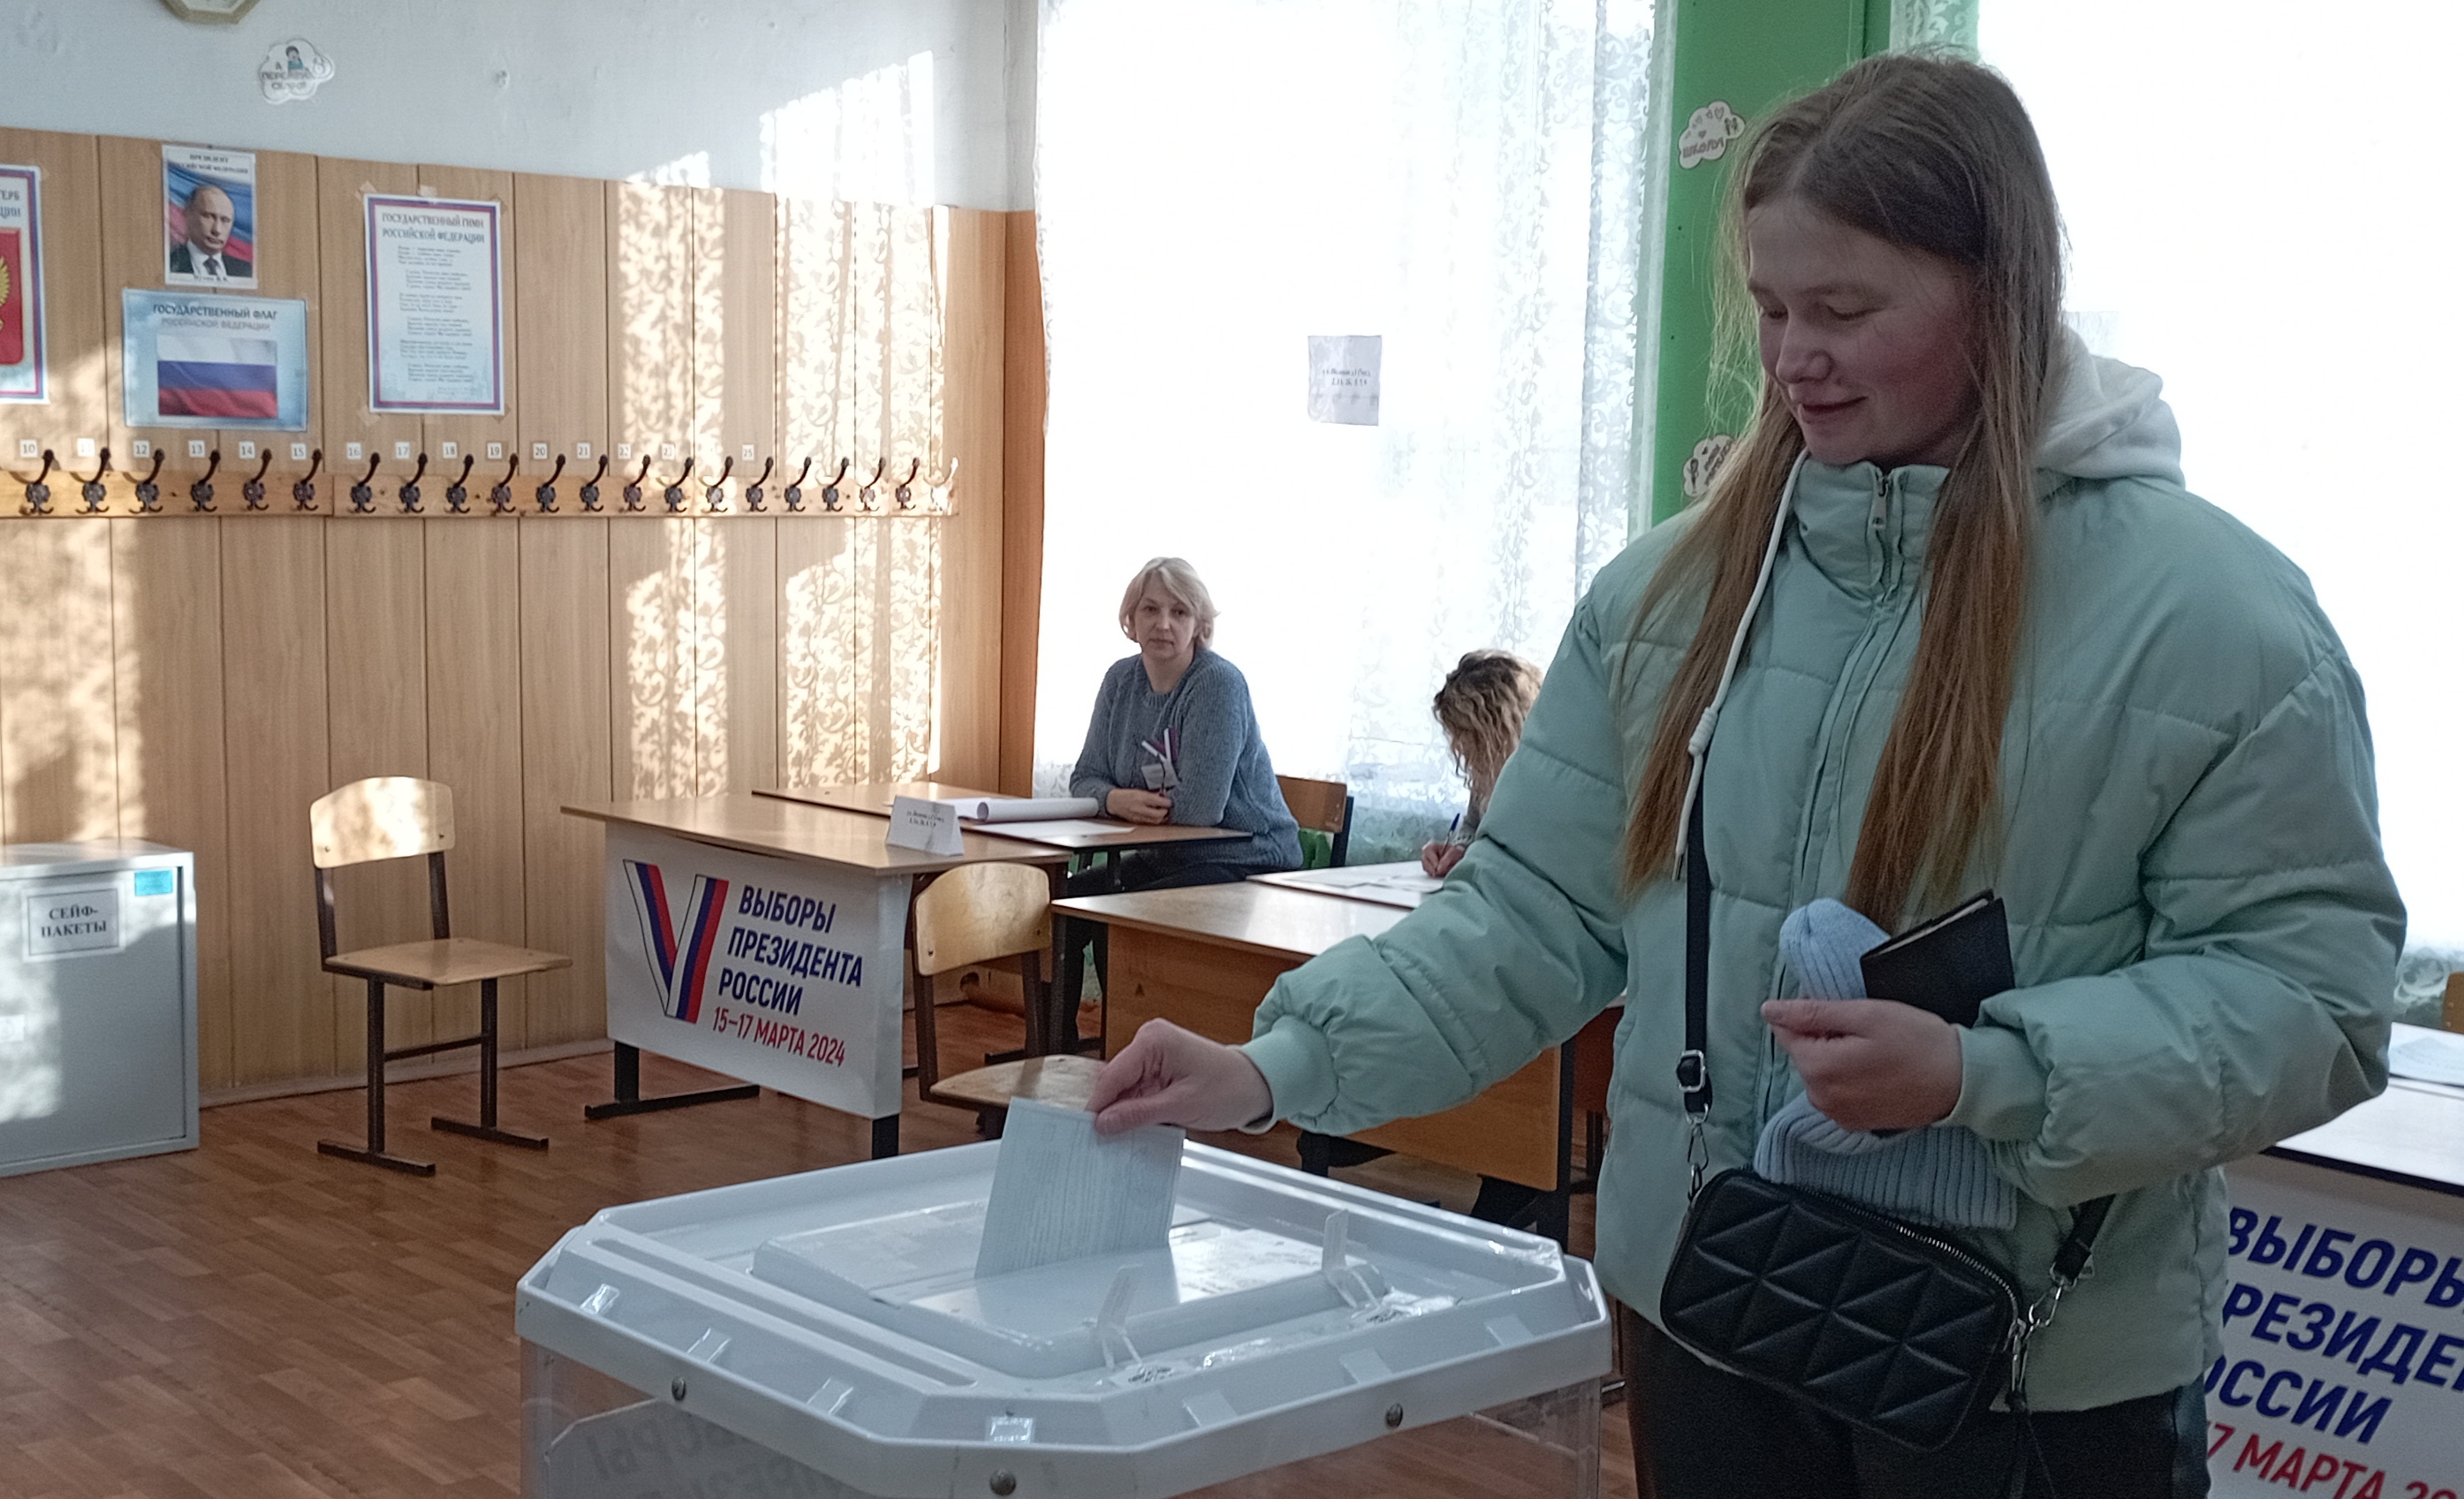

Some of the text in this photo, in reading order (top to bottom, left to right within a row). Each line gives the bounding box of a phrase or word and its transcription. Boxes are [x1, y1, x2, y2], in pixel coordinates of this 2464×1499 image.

[0, 189, 20, 201] ЕРБ
[383, 213, 460, 227] ГОСУДАРСТВЕННЫЙ
[382, 227, 485, 245] РОССИЙСКОЙ ФЕДЕРАЦИИ
[153, 303, 278, 321] ГОСУДАРСТВЕННЫЙ ФЛАГ
[23, 443, 35, 454] 10
[135, 444, 148, 454] 12
[191, 444, 203, 454] 13
[241, 445, 253, 456] 14
[293, 447, 305, 457] 15
[348, 446, 360, 457] 16
[397, 446, 409, 456] 17
[444, 446, 456, 456] 18
[489, 446, 500, 457] 19
[535, 446, 546, 457] 20
[578, 446, 588, 456] 21
[49, 904, 99, 920] СЕЙФ-
[739, 885, 837, 934] ВЫБОРЫ
[41, 920, 107, 938] ПАКЕТЫ
[727, 927, 863, 988] ПРЕЗИДЕНТА
[718, 968, 803, 1016] РОССИИ
[754, 1018, 805, 1056] МАРТА
[807, 1033, 846, 1067] 2024
[2222, 1283, 2464, 1392] РЕЗИДЕ
[2233, 1433, 2386, 1499] МАРТА
